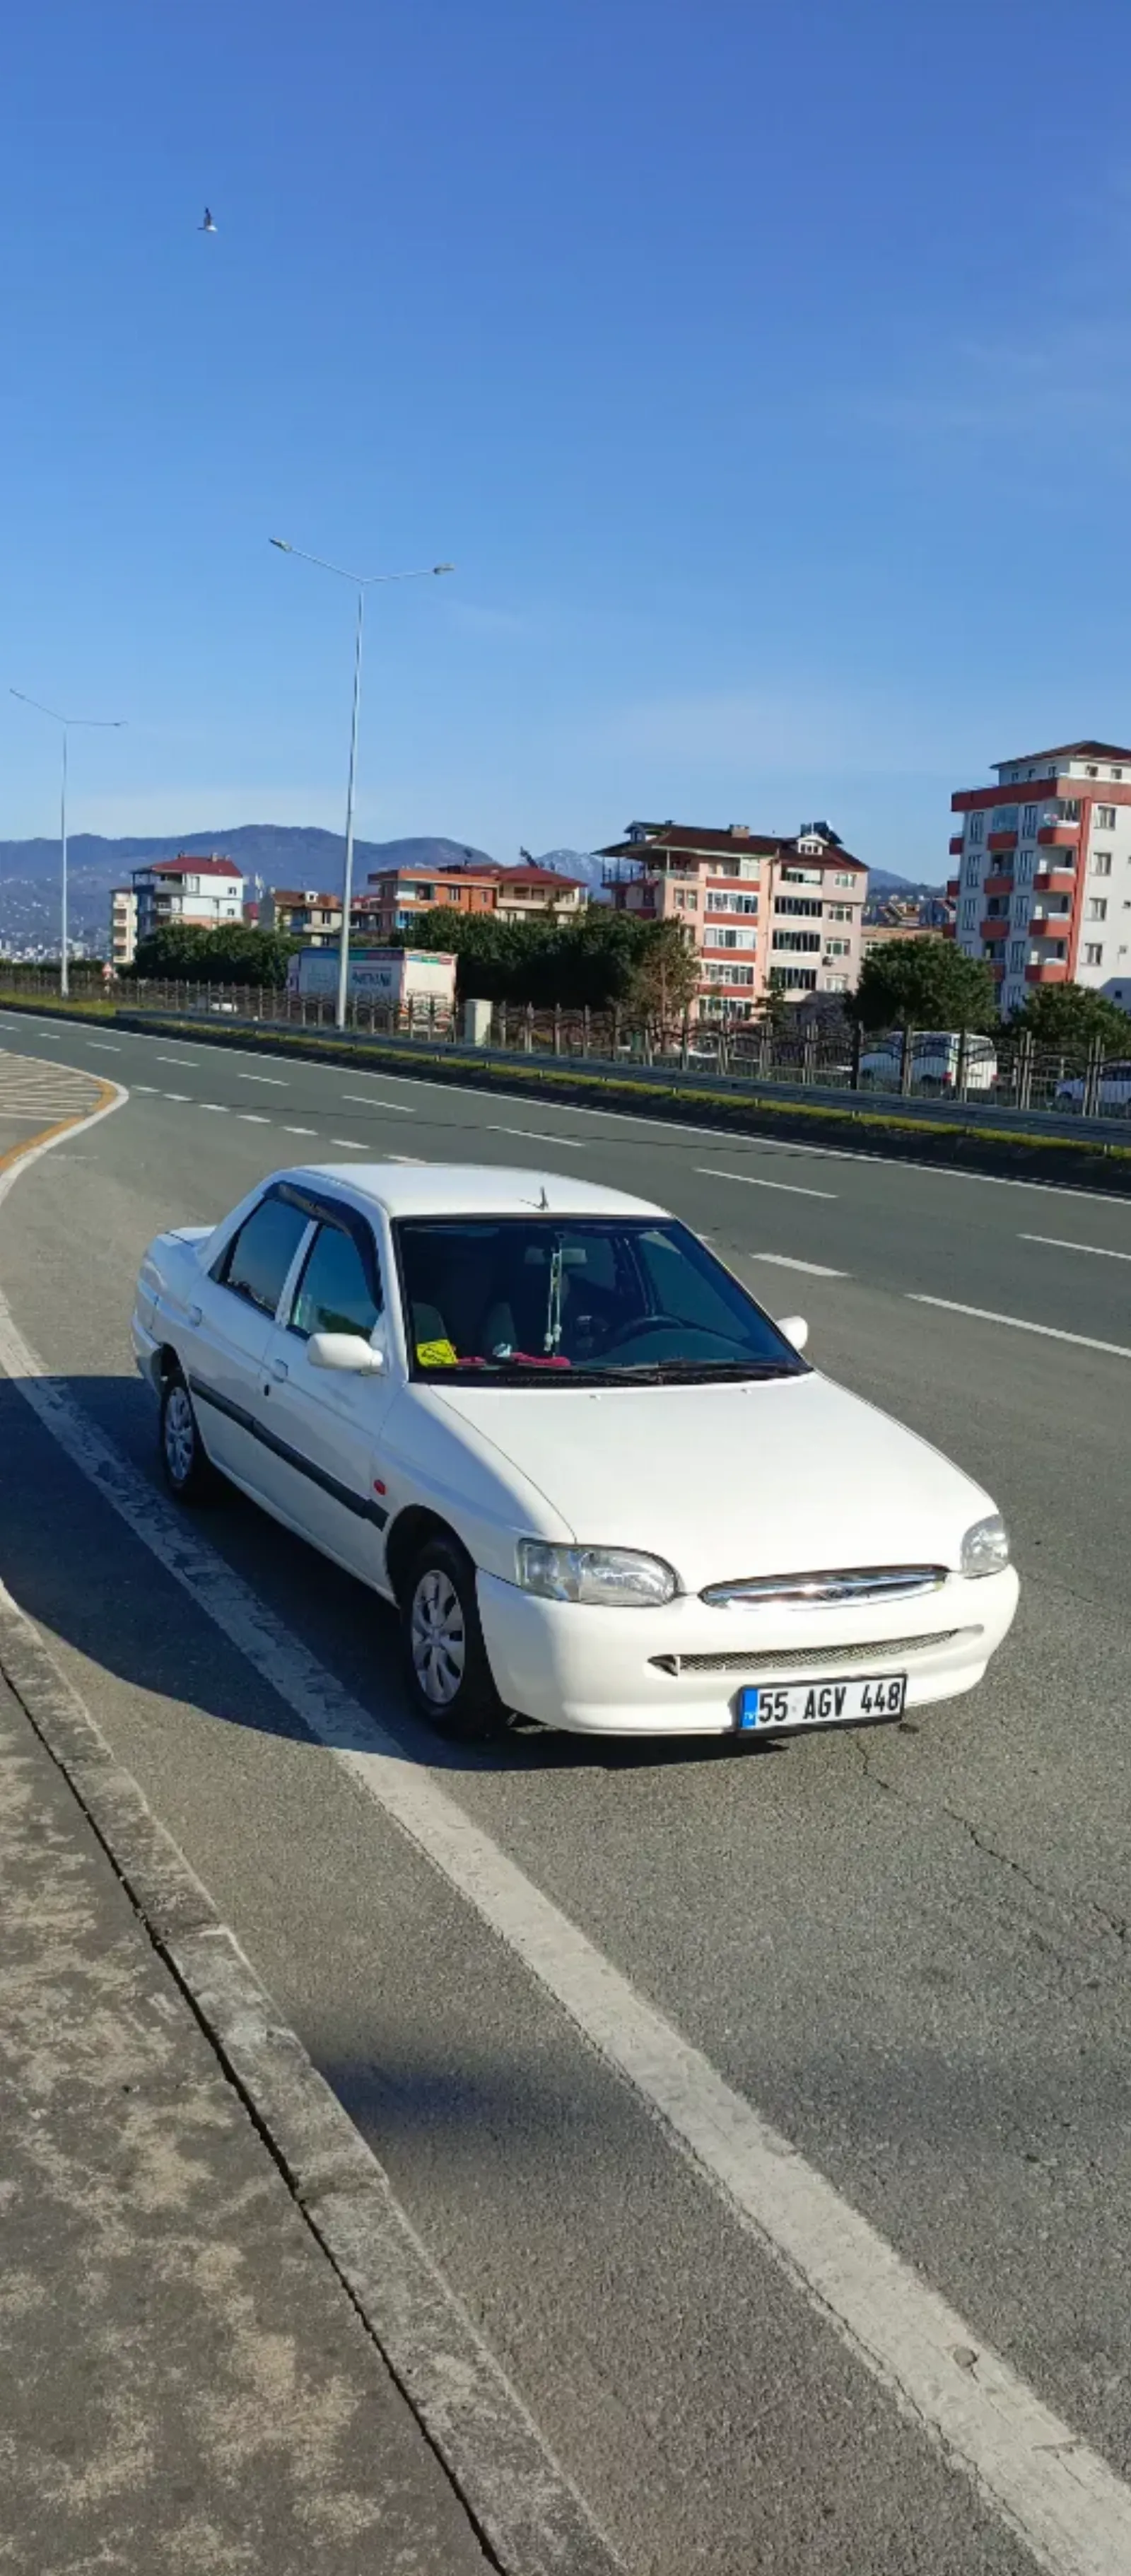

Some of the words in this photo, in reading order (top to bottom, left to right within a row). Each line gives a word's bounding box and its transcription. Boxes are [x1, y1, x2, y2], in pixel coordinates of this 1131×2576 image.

[758, 1692, 788, 1722] 55
[803, 1686, 846, 1720] AGV
[860, 1682, 901, 1713] 448
